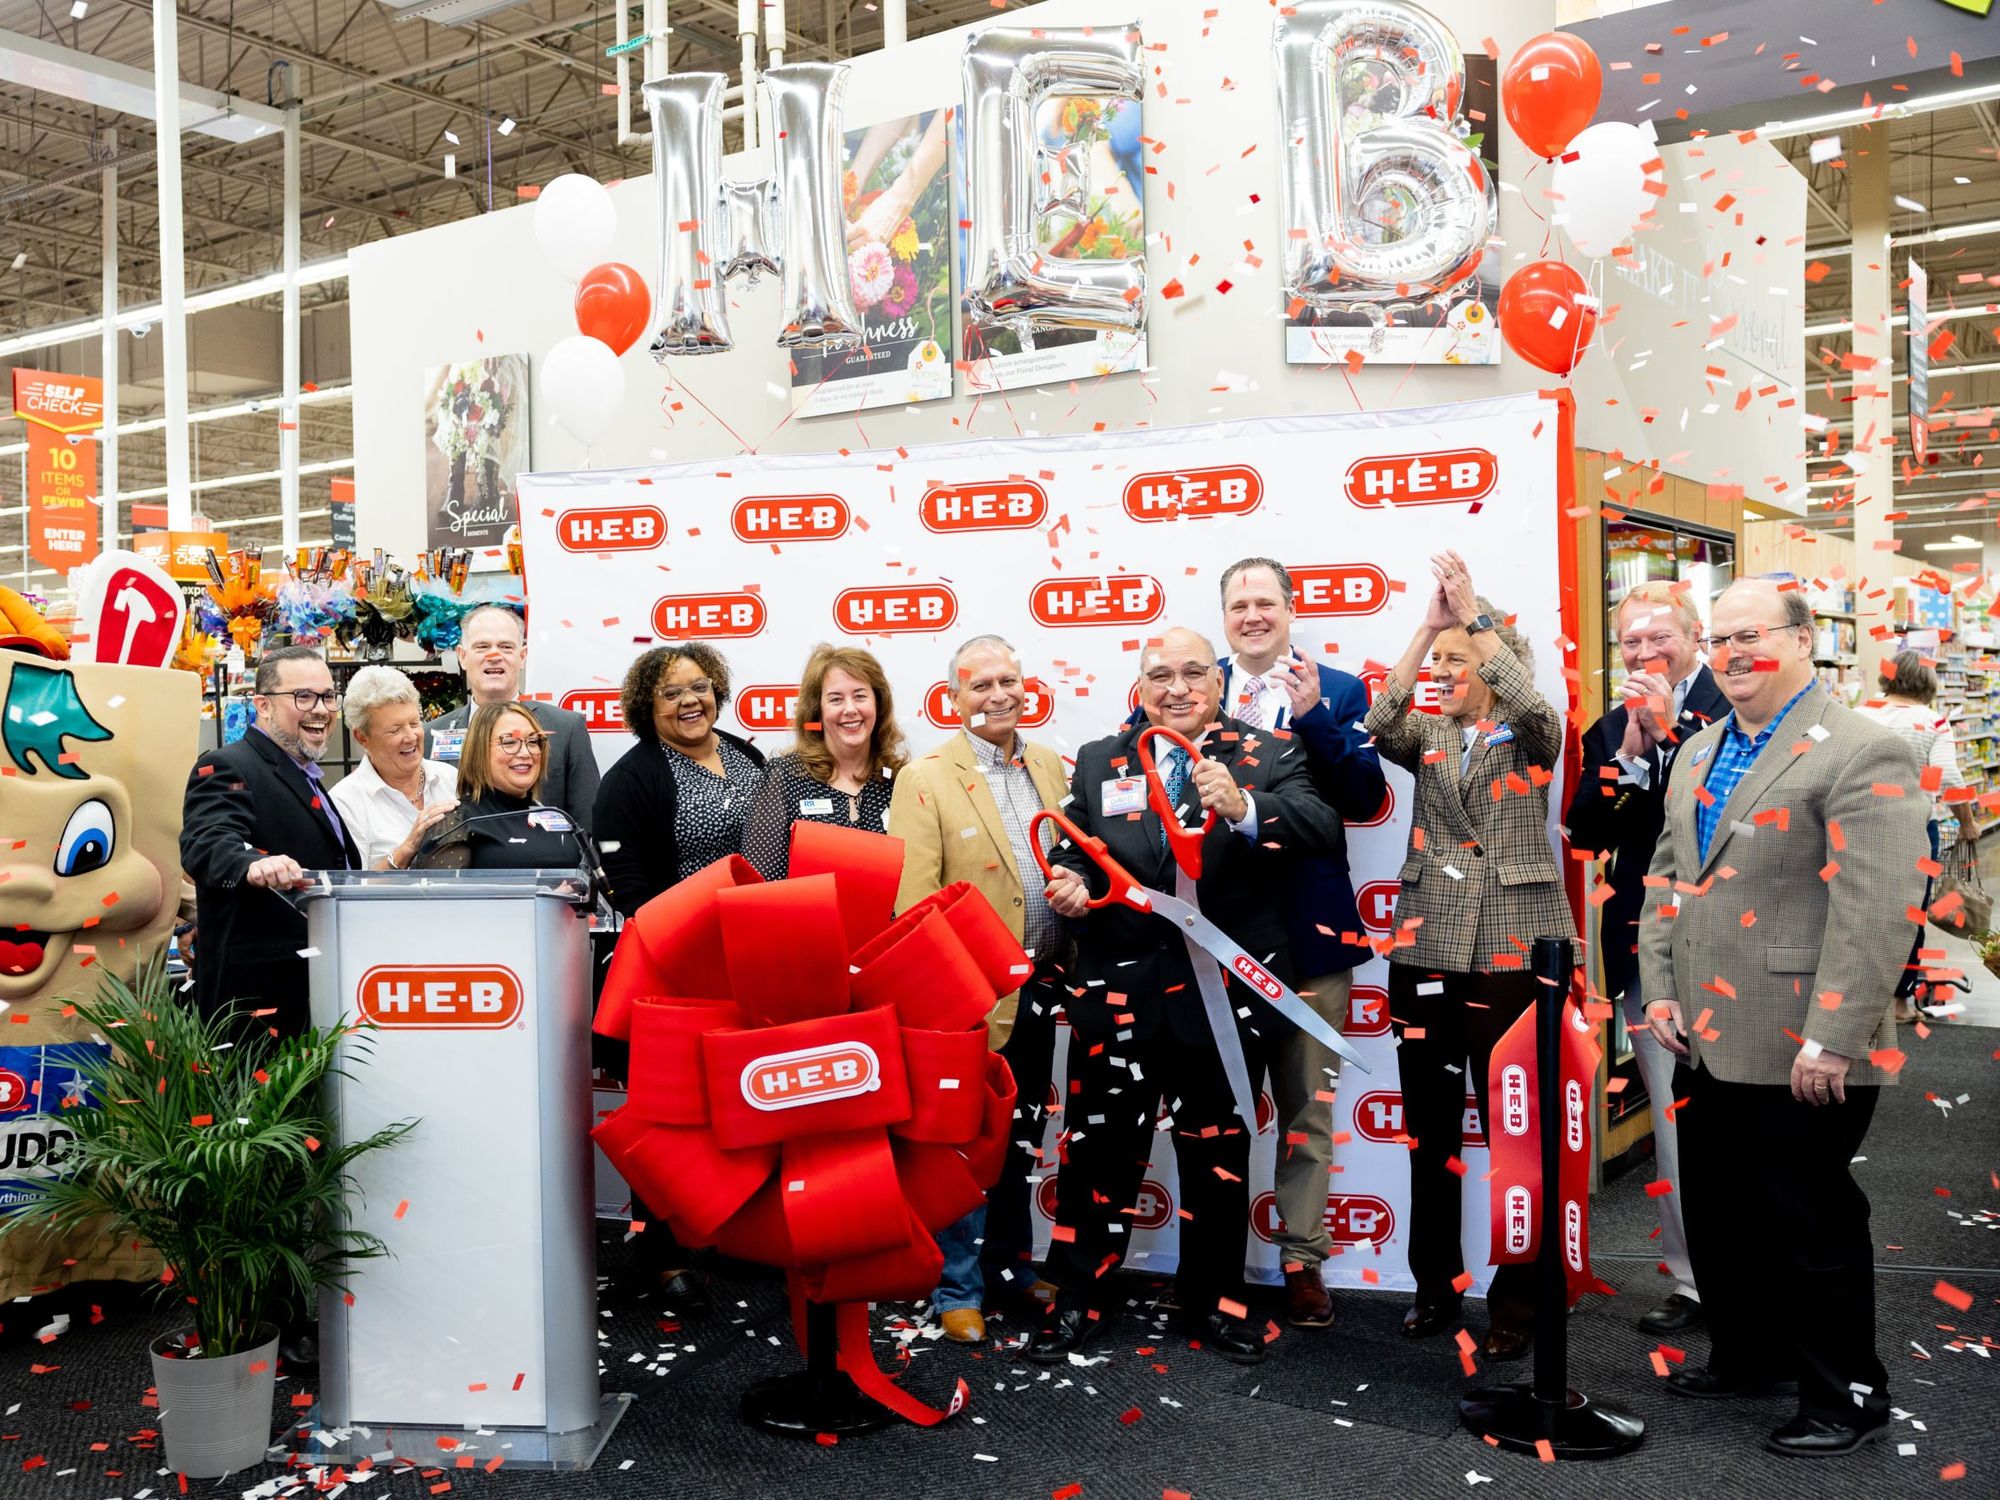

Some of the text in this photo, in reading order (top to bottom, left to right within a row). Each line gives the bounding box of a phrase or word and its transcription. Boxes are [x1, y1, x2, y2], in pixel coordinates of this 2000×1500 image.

[44, 383, 86, 401] SELF
[27, 395, 82, 415] CHECK
[49, 448, 76, 470] 10
[41, 471, 84, 488] ITEMS
[56, 486, 71, 496] OR
[42, 496, 85, 508] FEWER
[447, 496, 508, 537] Special
[44, 528, 86, 541] ENTER
[48, 539, 83, 552] HERE
[176, 555, 209, 566] CHEC
[181, 585, 207, 596] expr
[1293, 577, 1374, 605] -E-B
[377, 982, 504, 1013] H-E-B
[762, 1059, 858, 1094] H-E-B
